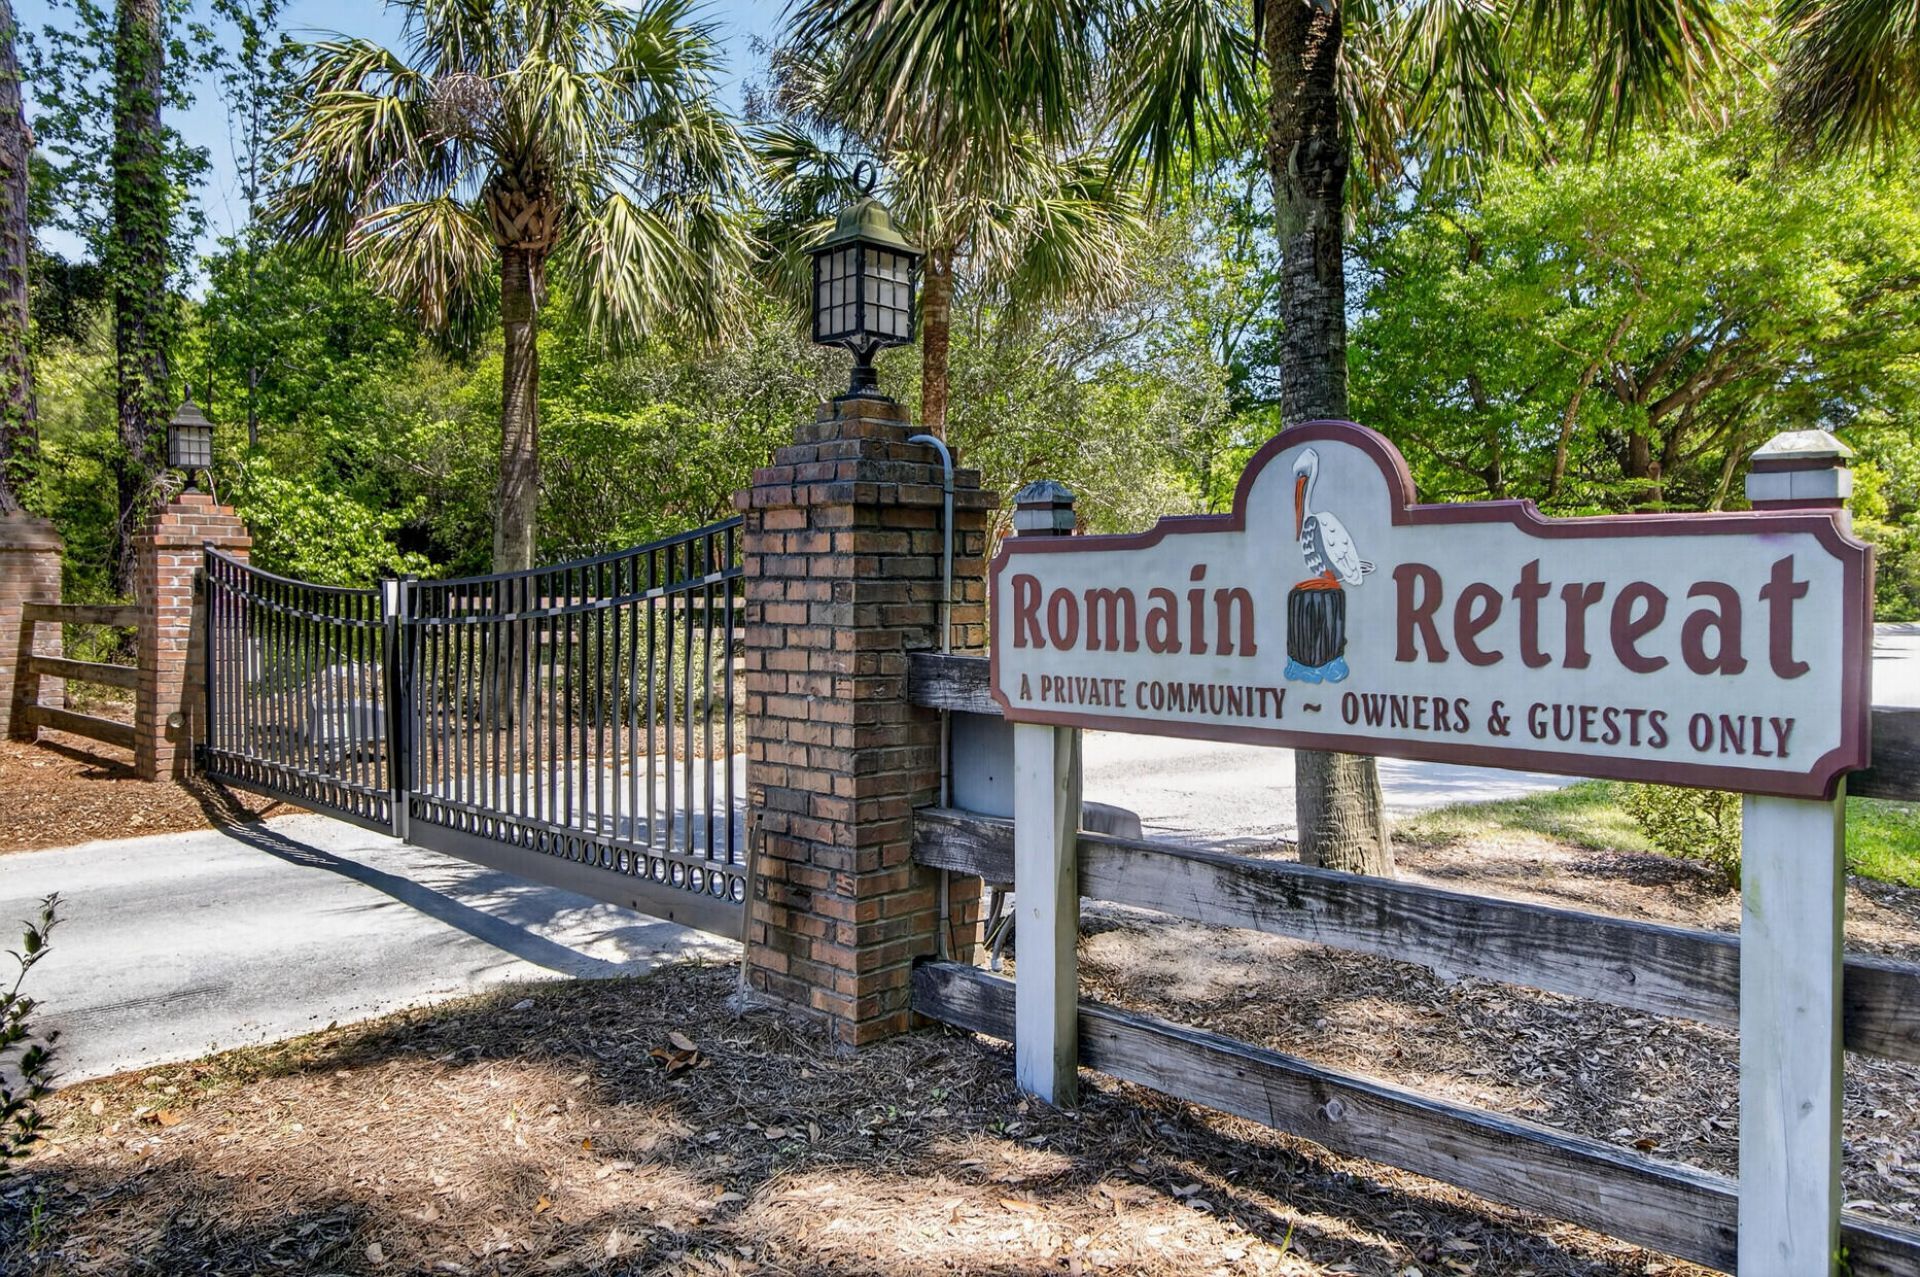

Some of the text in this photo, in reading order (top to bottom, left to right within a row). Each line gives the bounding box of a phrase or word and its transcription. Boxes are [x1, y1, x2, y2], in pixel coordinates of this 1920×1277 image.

[1011, 554, 1811, 680] Romain Retreat
[1020, 673, 1031, 701] A
[1040, 674, 1127, 711] PRIVATE
[1135, 681, 1286, 720] COMMUNITY
[1341, 691, 1471, 733] OWNERS
[1487, 699, 1511, 737] &
[1527, 702, 1669, 749] GUESTS
[1688, 712, 1795, 759] ONLY
